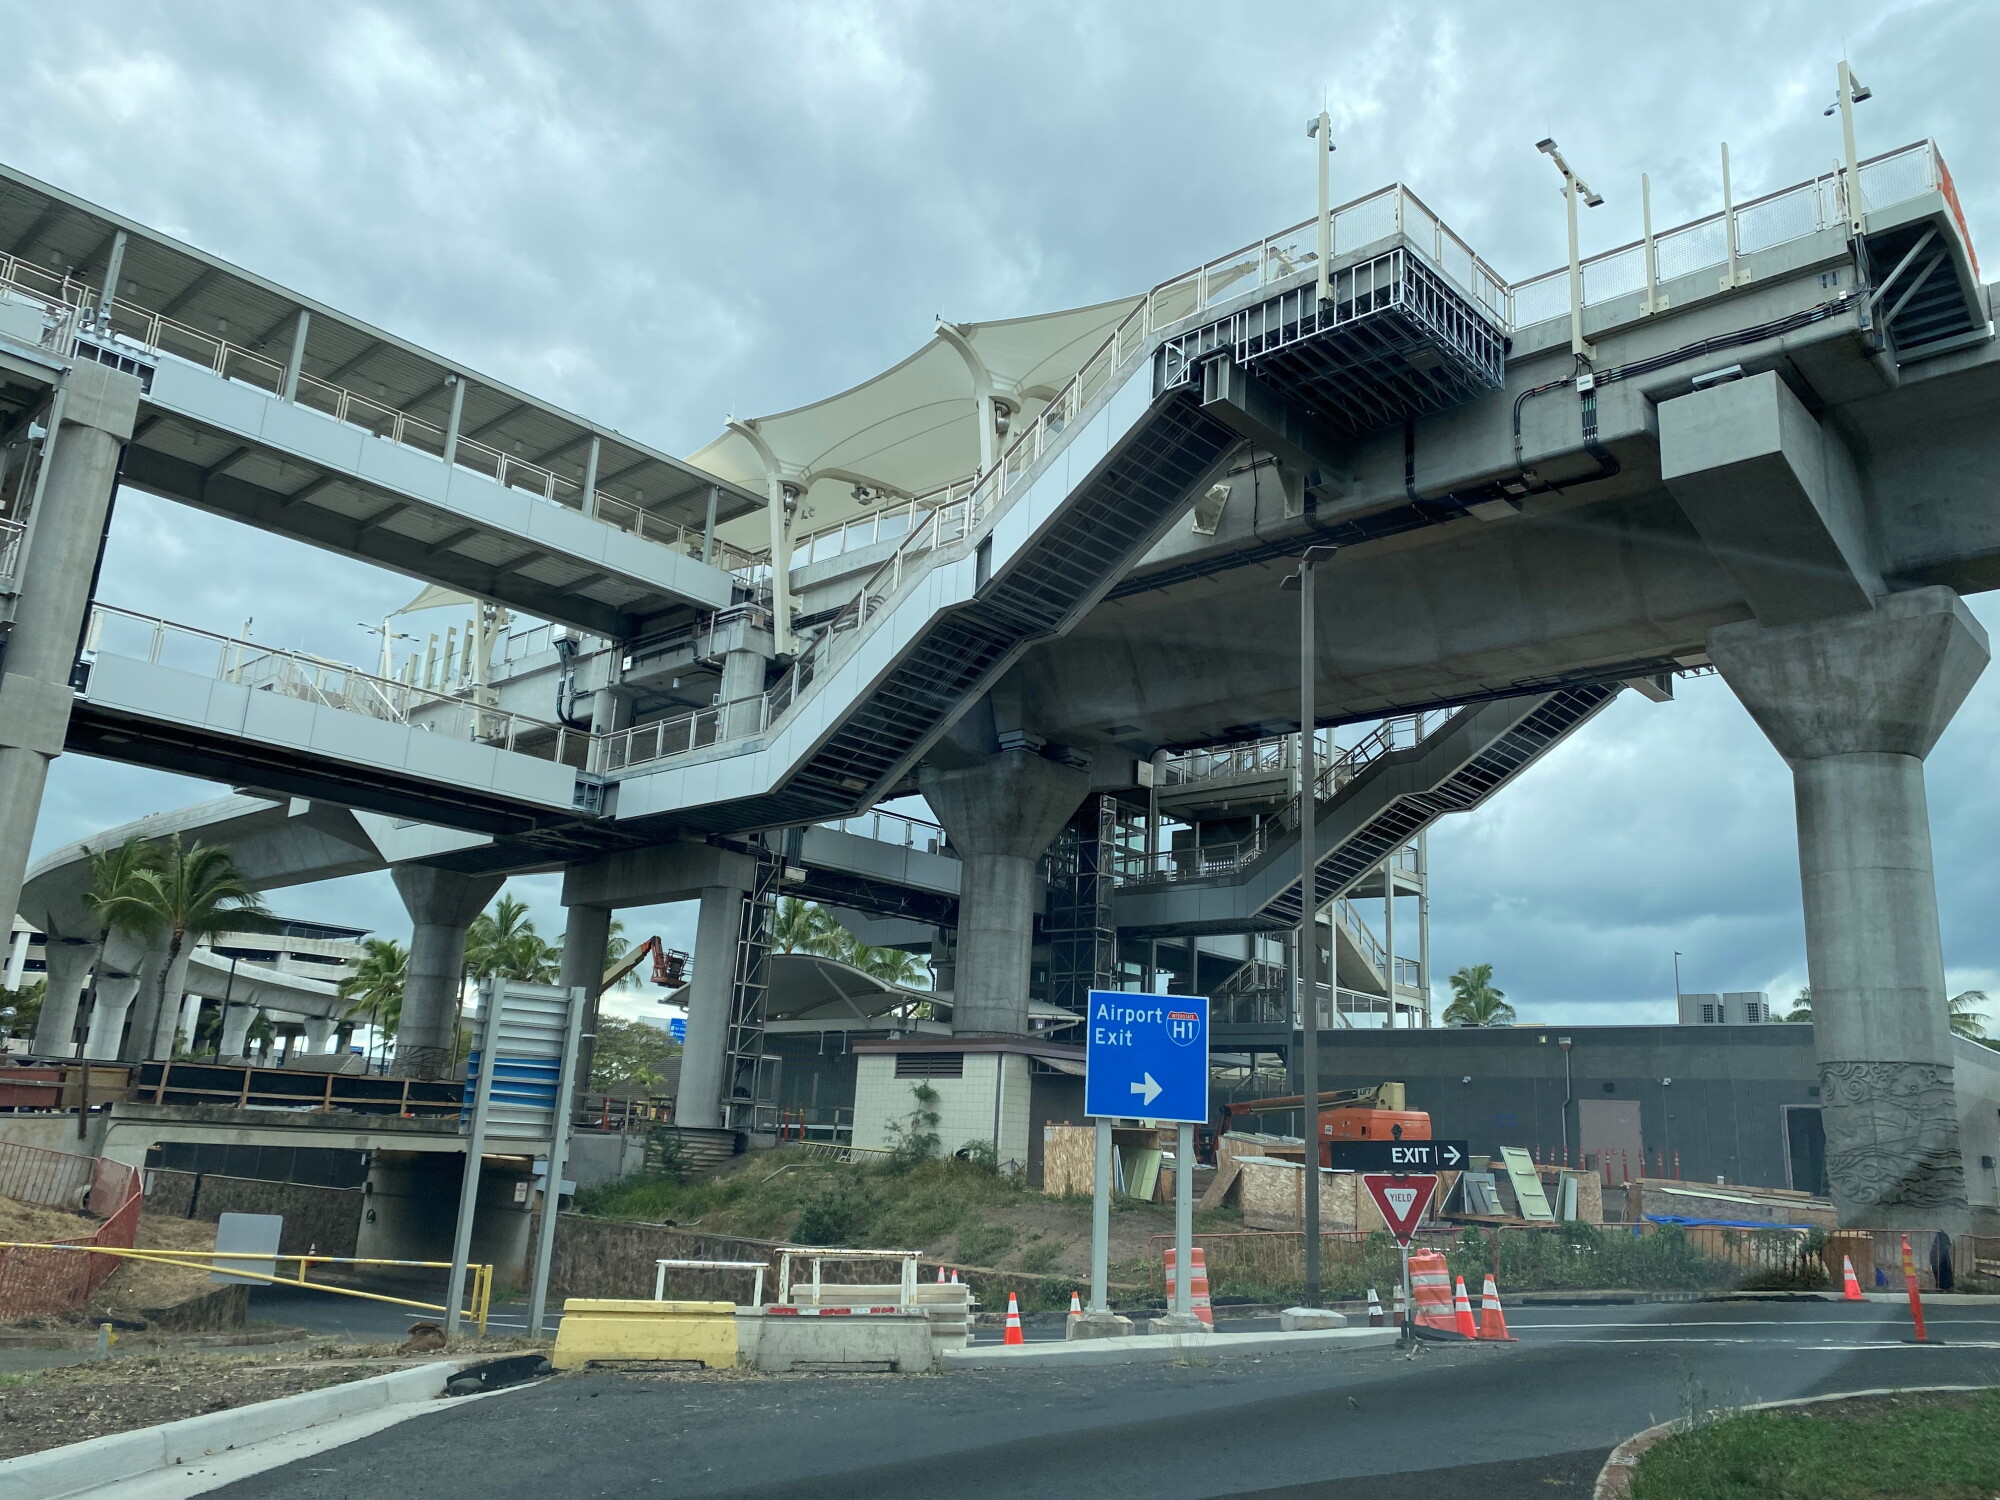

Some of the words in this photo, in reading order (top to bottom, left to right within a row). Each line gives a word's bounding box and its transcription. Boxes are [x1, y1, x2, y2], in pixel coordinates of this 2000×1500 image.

[1096, 1003, 1163, 1025] Airport
[1171, 1012, 1196, 1020] INTERSTATE
[1095, 1027, 1133, 1046] Exit
[1173, 1020, 1193, 1039] H1
[1391, 1147, 1430, 1164] EXIT
[1390, 1193, 1412, 1202] YIELD
